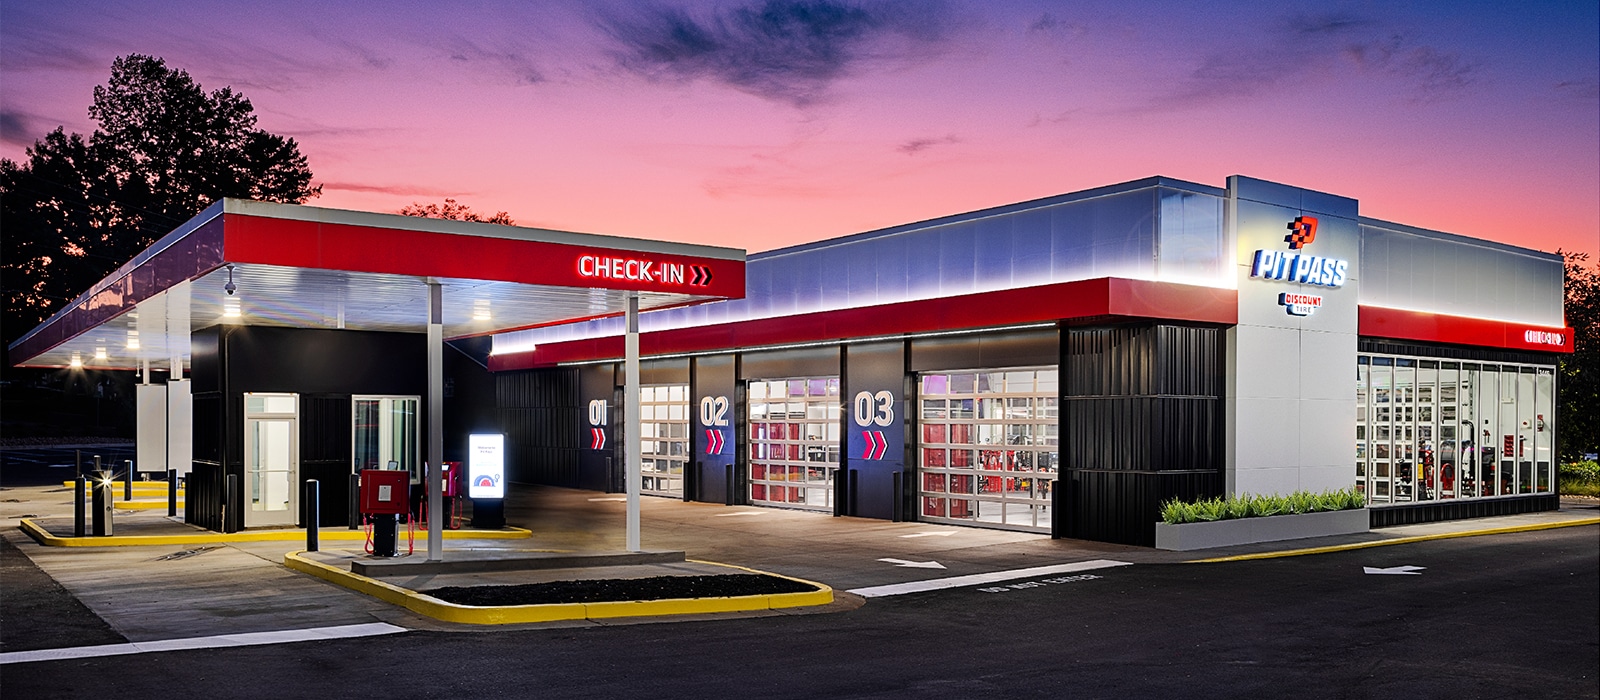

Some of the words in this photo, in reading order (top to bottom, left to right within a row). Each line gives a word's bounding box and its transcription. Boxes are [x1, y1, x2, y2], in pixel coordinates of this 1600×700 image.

[579, 256, 684, 283] CHECK-IN
[1251, 249, 1295, 282] PIT
[1290, 253, 1348, 287] PASS
[1286, 294, 1321, 306] DISCOUNT
[1296, 306, 1312, 314] TIRE
[589, 399, 607, 426] 01
[700, 395, 729, 426] 02
[854, 390, 894, 427] 03
